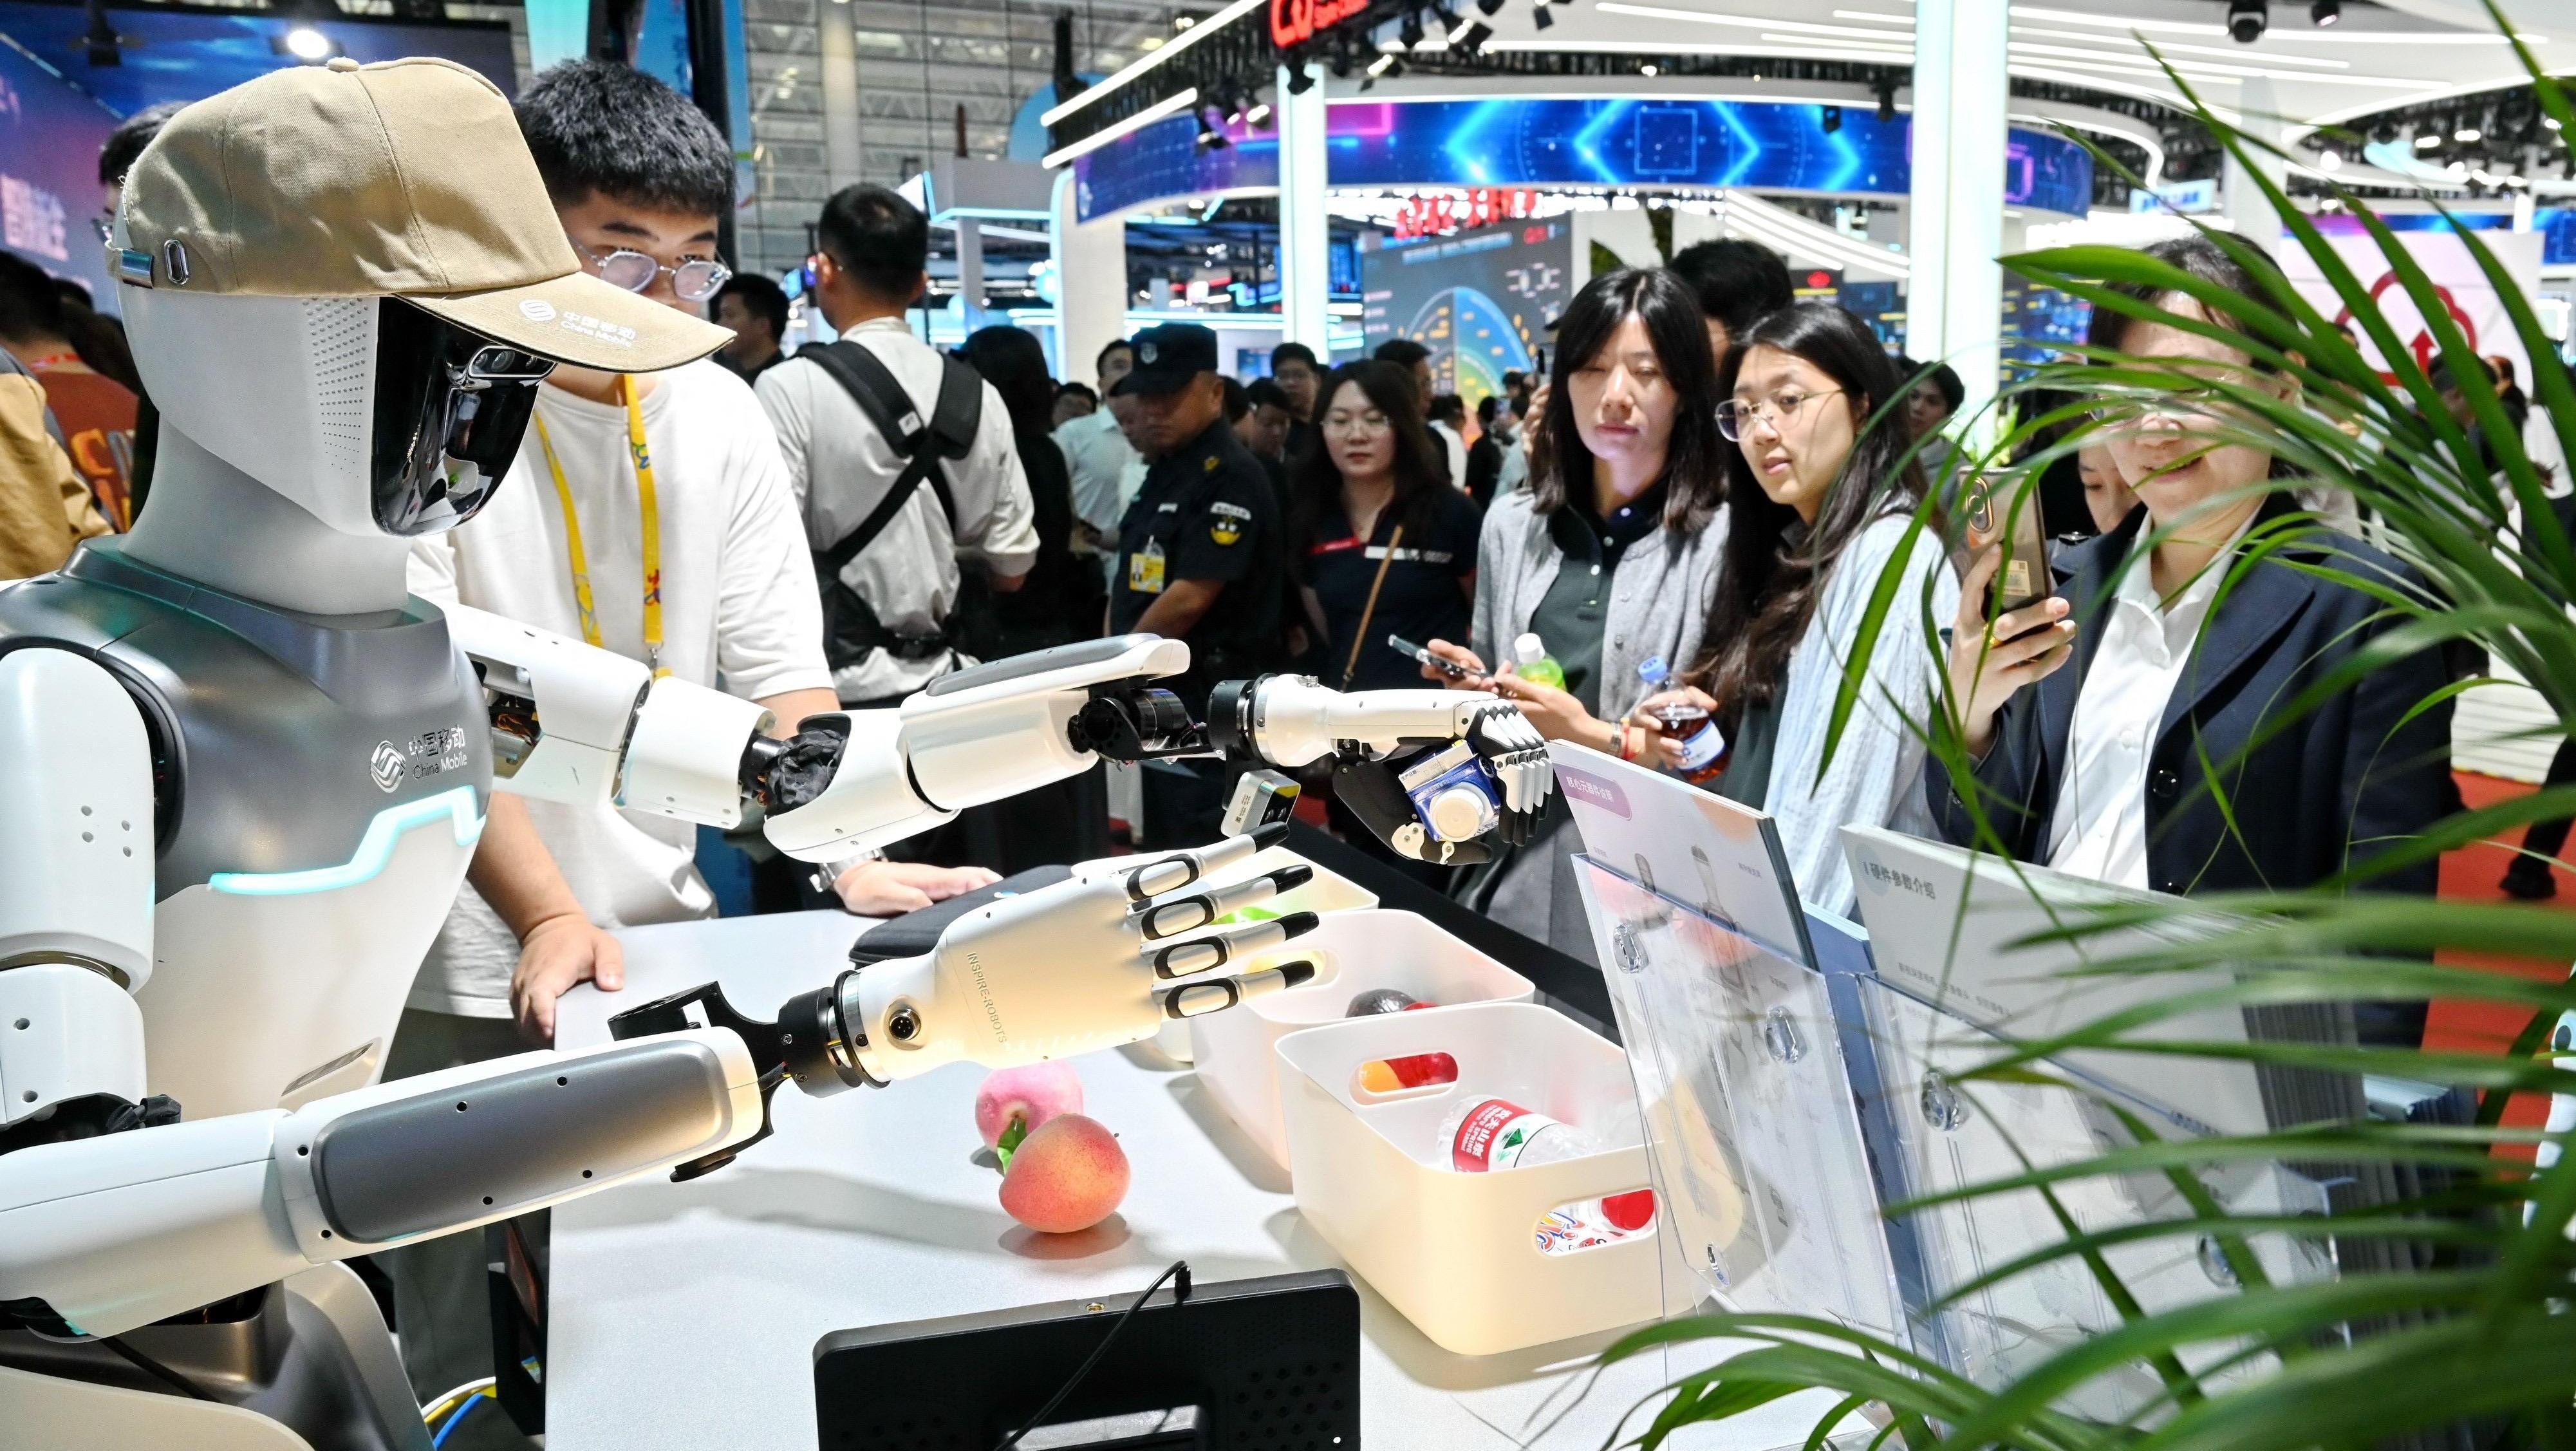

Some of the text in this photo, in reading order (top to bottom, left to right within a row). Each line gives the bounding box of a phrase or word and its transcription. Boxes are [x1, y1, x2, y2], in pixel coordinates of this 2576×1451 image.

[561, 321, 633, 348] China Mobile
[563, 310, 636, 340] 中国移动
[408, 724, 465, 761] 中国移动
[413, 751, 467, 780] China Mobile
[967, 951, 1007, 1043] INSPIRE-ROBOTS
[1466, 1127, 1481, 1154] SPRING
[1471, 1109, 1513, 1157] 农夫山泉
